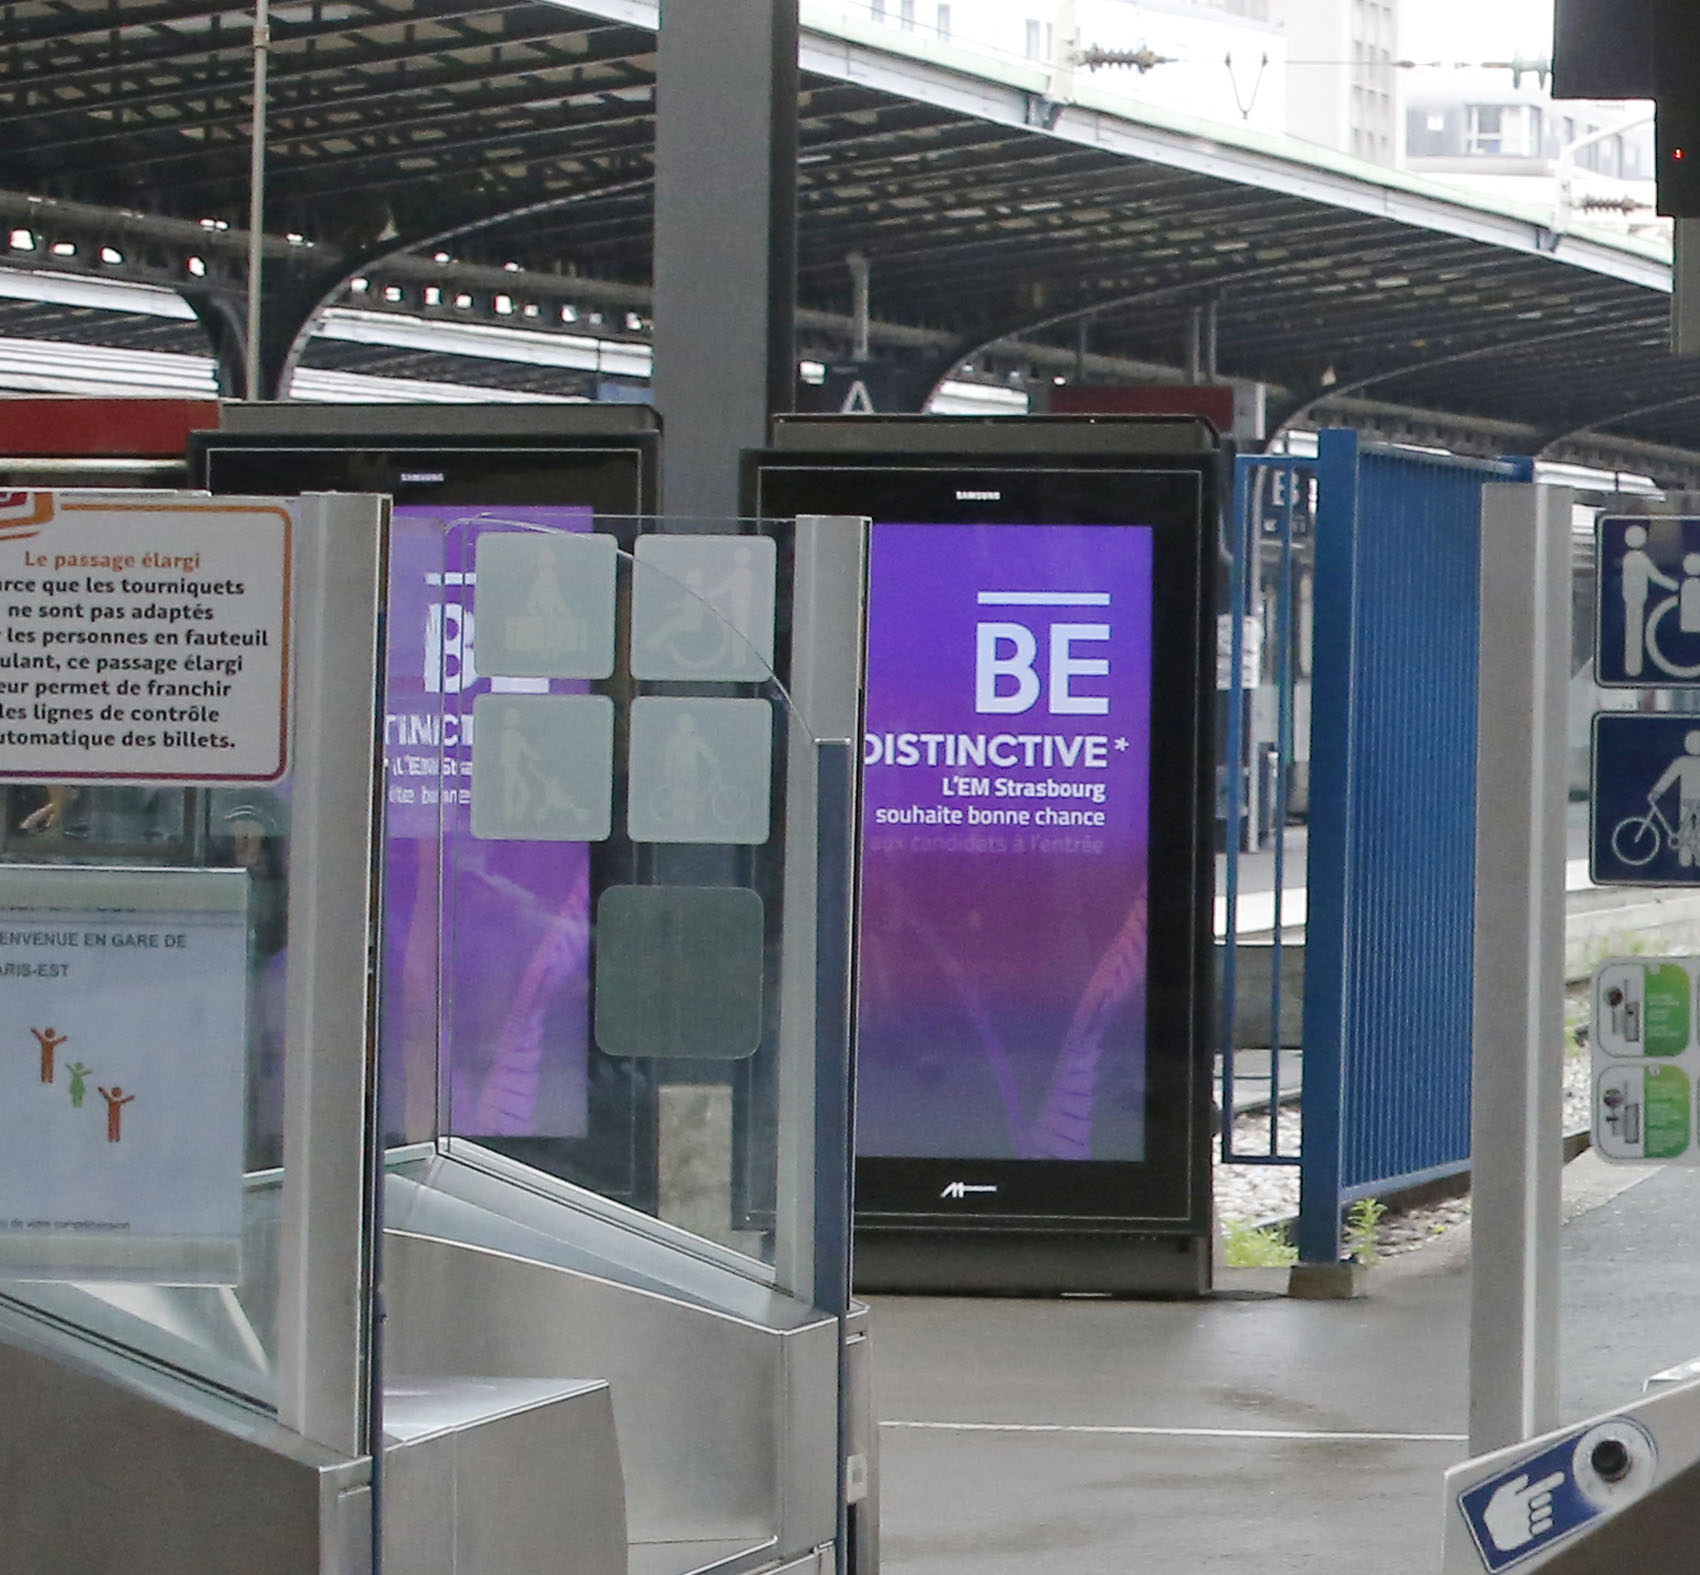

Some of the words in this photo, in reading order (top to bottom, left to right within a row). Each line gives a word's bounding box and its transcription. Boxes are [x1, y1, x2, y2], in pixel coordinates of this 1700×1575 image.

[25, 551, 48, 568] Le
[55, 554, 135, 572] passage
[142, 551, 200, 573] élargi
[42, 580, 79, 597] que
[86, 577, 116, 593] les
[122, 578, 245, 598] tourniquets
[8, 605, 32, 617] ne
[39, 603, 84, 618] sont
[90, 605, 126, 622] pas
[132, 603, 214, 623] adaptés
[8, 627, 36, 643] les
[42, 631, 148, 648] personnes
[155, 632, 179, 646] en
[186, 628, 268, 648] fauteuil
[67, 656, 91, 670] ce
[96, 656, 178, 675] passage
[184, 654, 243, 676] élargi
[975, 621, 1111, 715] BE
[36, 680, 111, 699] permet
[117, 680, 141, 696] de
[148, 680, 232, 698] franchir
[34, 703, 94, 725] lignes
[100, 704, 124, 721] de
[131, 705, 220, 723] contrôle
[122, 729, 156, 747] des
[163, 731, 236, 750] billets.
[942, 776, 990, 797] L'EM
[994, 777, 1107, 803] Strasbourg
[875, 804, 963, 825] souhaite
[967, 805, 1031, 825] bonne
[1034, 805, 1106, 827] chance
[112, 933, 159, 949] GARE
[164, 934, 188, 949] DE
